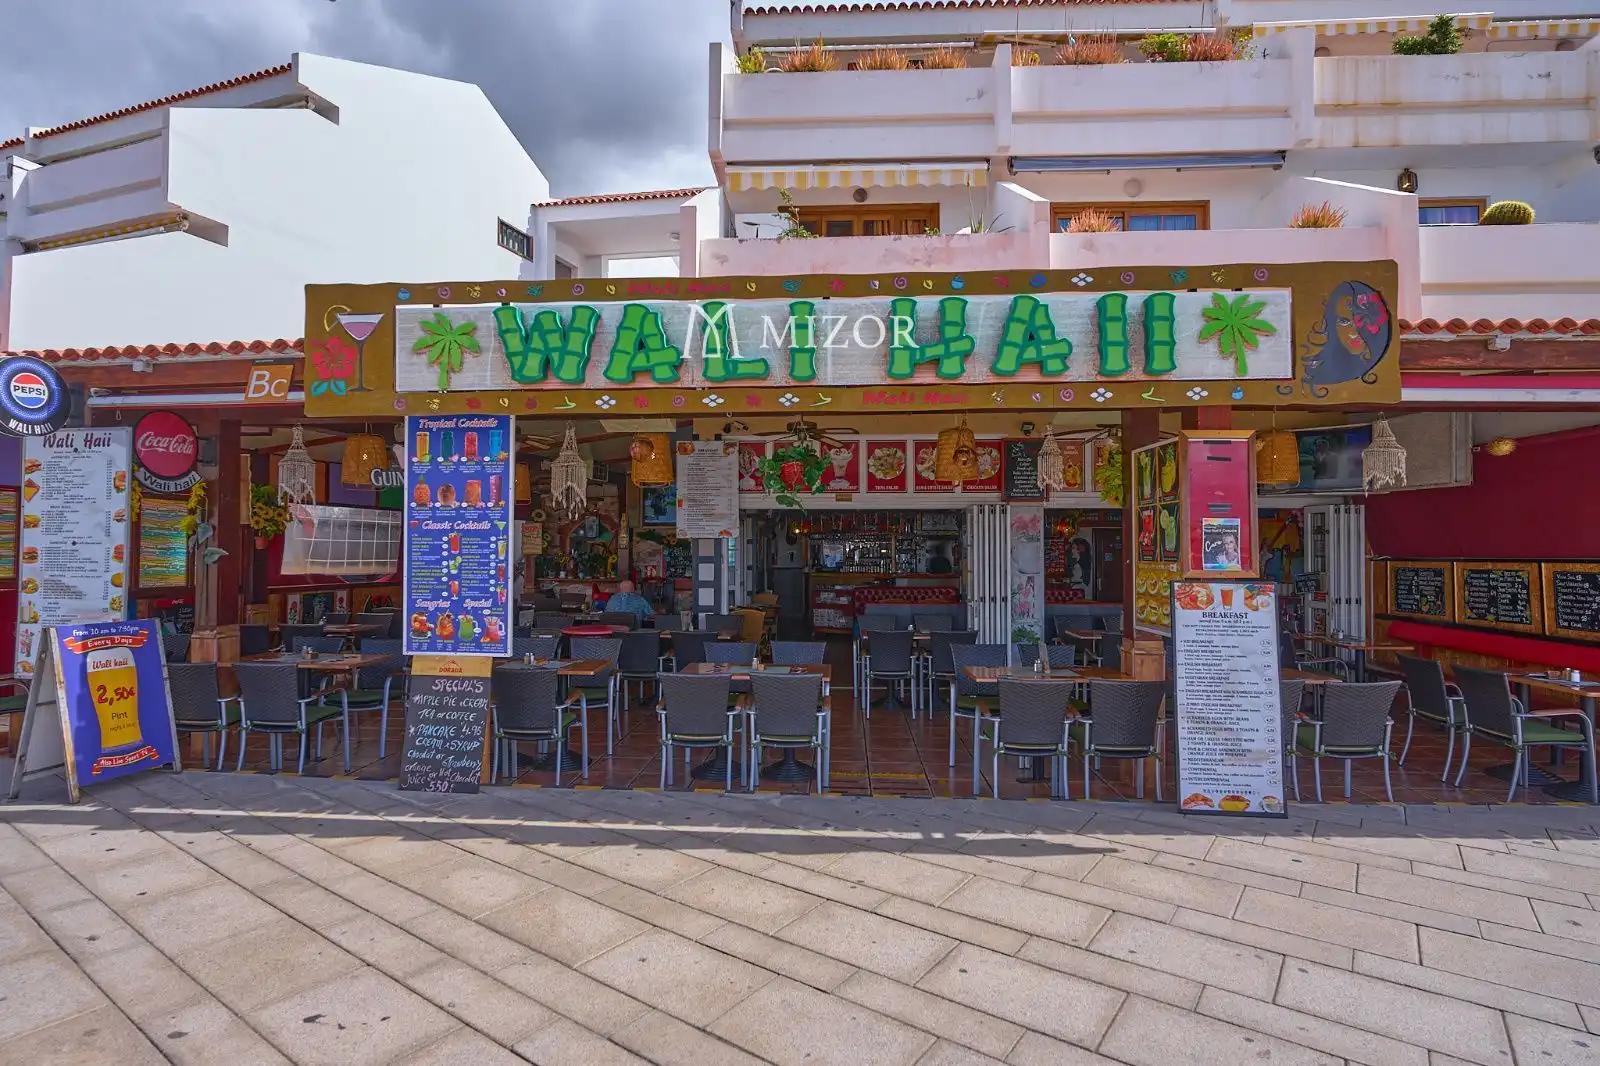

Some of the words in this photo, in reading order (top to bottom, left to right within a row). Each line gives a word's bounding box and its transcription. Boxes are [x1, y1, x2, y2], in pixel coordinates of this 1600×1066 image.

[492, 300, 816, 384] WALI
[887, 292, 1176, 379] HAII
[13, 385, 46, 397] PEPSI
[248, 370, 288, 398] Bc
[8, 418, 32, 435] WALI
[34, 422, 54, 435] HAII
[419, 418, 456, 431] Tropical
[458, 418, 498, 428] Cocktails
[43, 433, 74, 449] Wali
[84, 432, 112, 449] Haii
[137, 432, 195, 455] Coca-Cola
[143, 471, 171, 492] Wali
[174, 474, 198, 491] haii
[422, 520, 452, 530] Classic
[454, 520, 492, 530] Cocktails
[462, 598, 492, 610] Special
[87, 639, 111, 647] Every
[92, 659, 112, 670] Wali
[432, 679, 484, 693] SPECIAL'S
[111, 712, 128, 720] Pint
[418, 709, 436, 720] TEA
[417, 724, 457, 739] PANCAKE
[416, 737, 443, 749] CREAM
[450, 740, 481, 752] SYRUP
